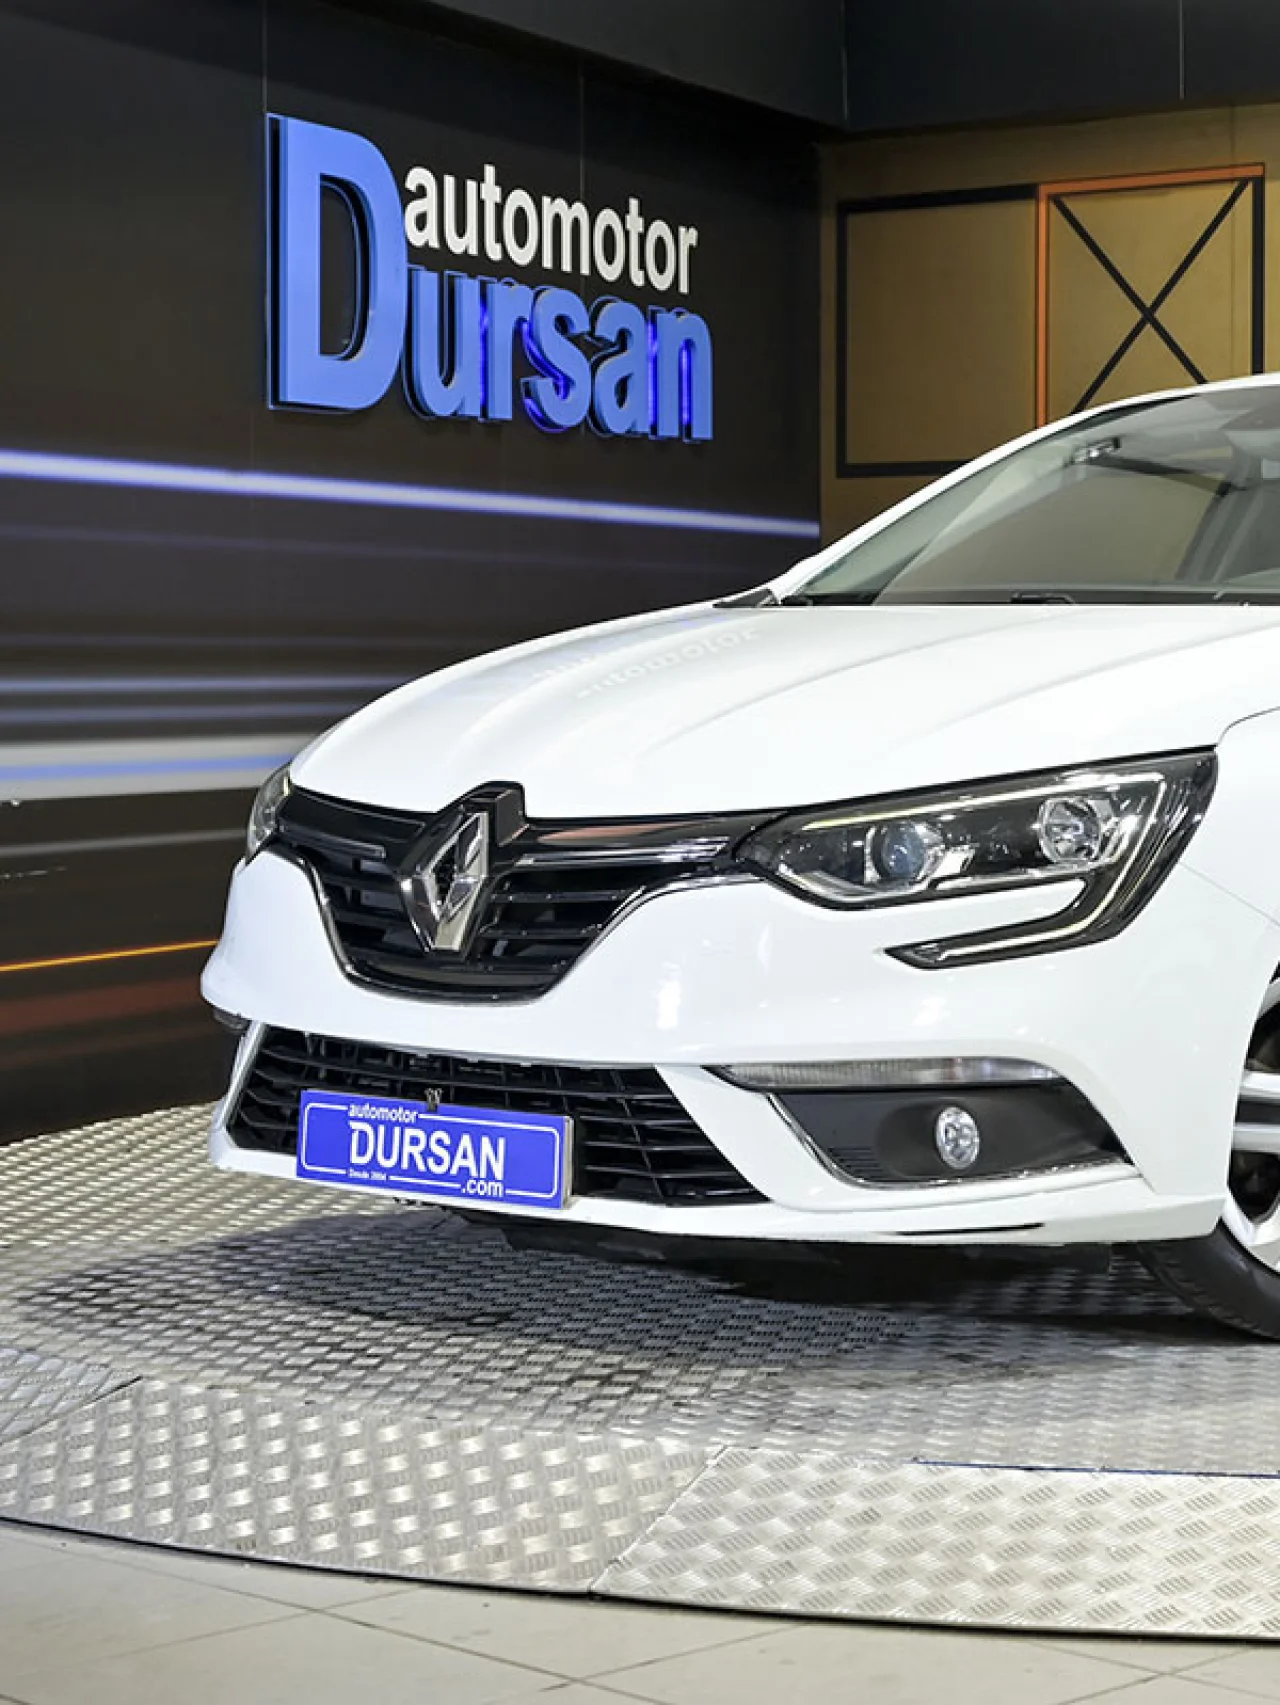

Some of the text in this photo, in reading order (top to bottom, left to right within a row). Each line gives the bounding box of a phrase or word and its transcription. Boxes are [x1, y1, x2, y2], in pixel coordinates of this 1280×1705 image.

[404, 163, 699, 295] automotor
[266, 112, 714, 442] Dursan
[347, 1103, 419, 1123] automotor
[348, 1120, 506, 1181] DURSAN
[461, 1178, 504, 1197] .com
